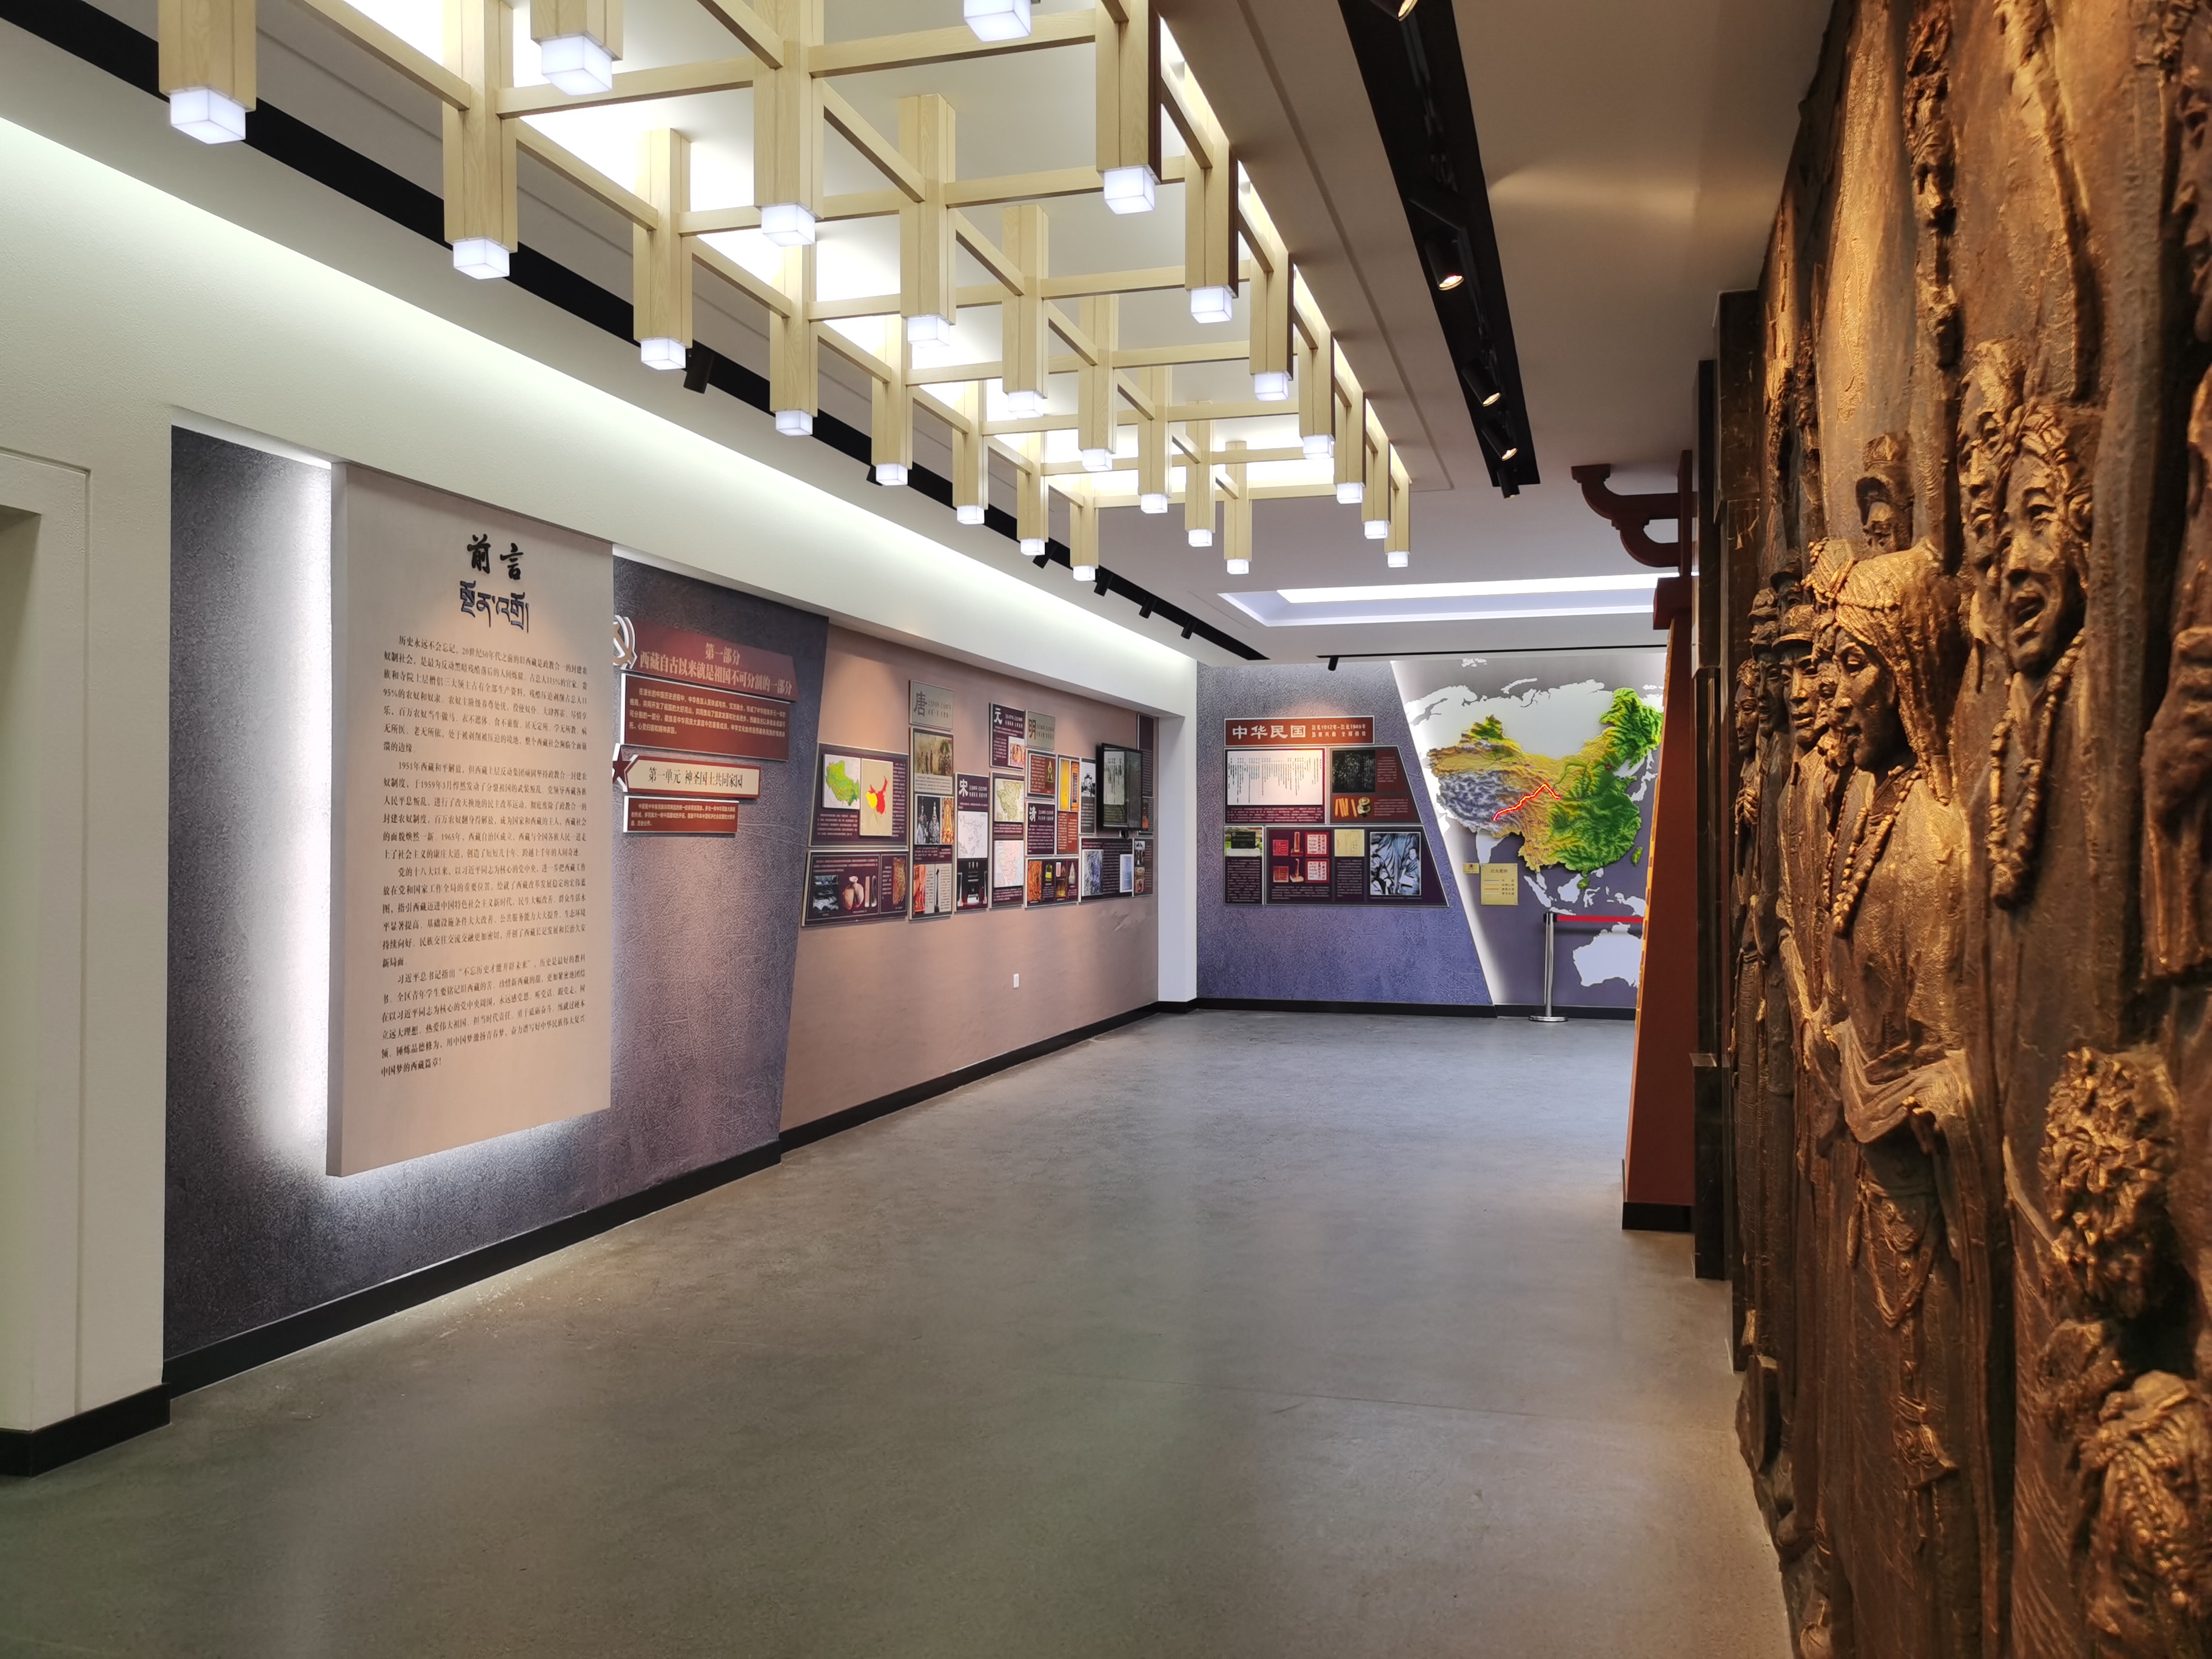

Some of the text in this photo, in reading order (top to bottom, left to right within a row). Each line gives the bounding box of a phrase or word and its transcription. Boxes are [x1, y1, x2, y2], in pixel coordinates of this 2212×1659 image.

[467, 534, 525, 580] 前言
[705, 642, 740, 666] 第一部分
[639, 650, 793, 695] 西藏自古以来就是祖国不可分割的一部分
[914, 691, 928, 717] 唐
[994, 708, 1003, 725] 元
[1028, 719, 1036, 740] 明
[1232, 725, 1306, 740] 中华民国
[648, 766, 743, 788] 第一单元 神圣国土共同家园
[958, 778, 969, 798] 宋
